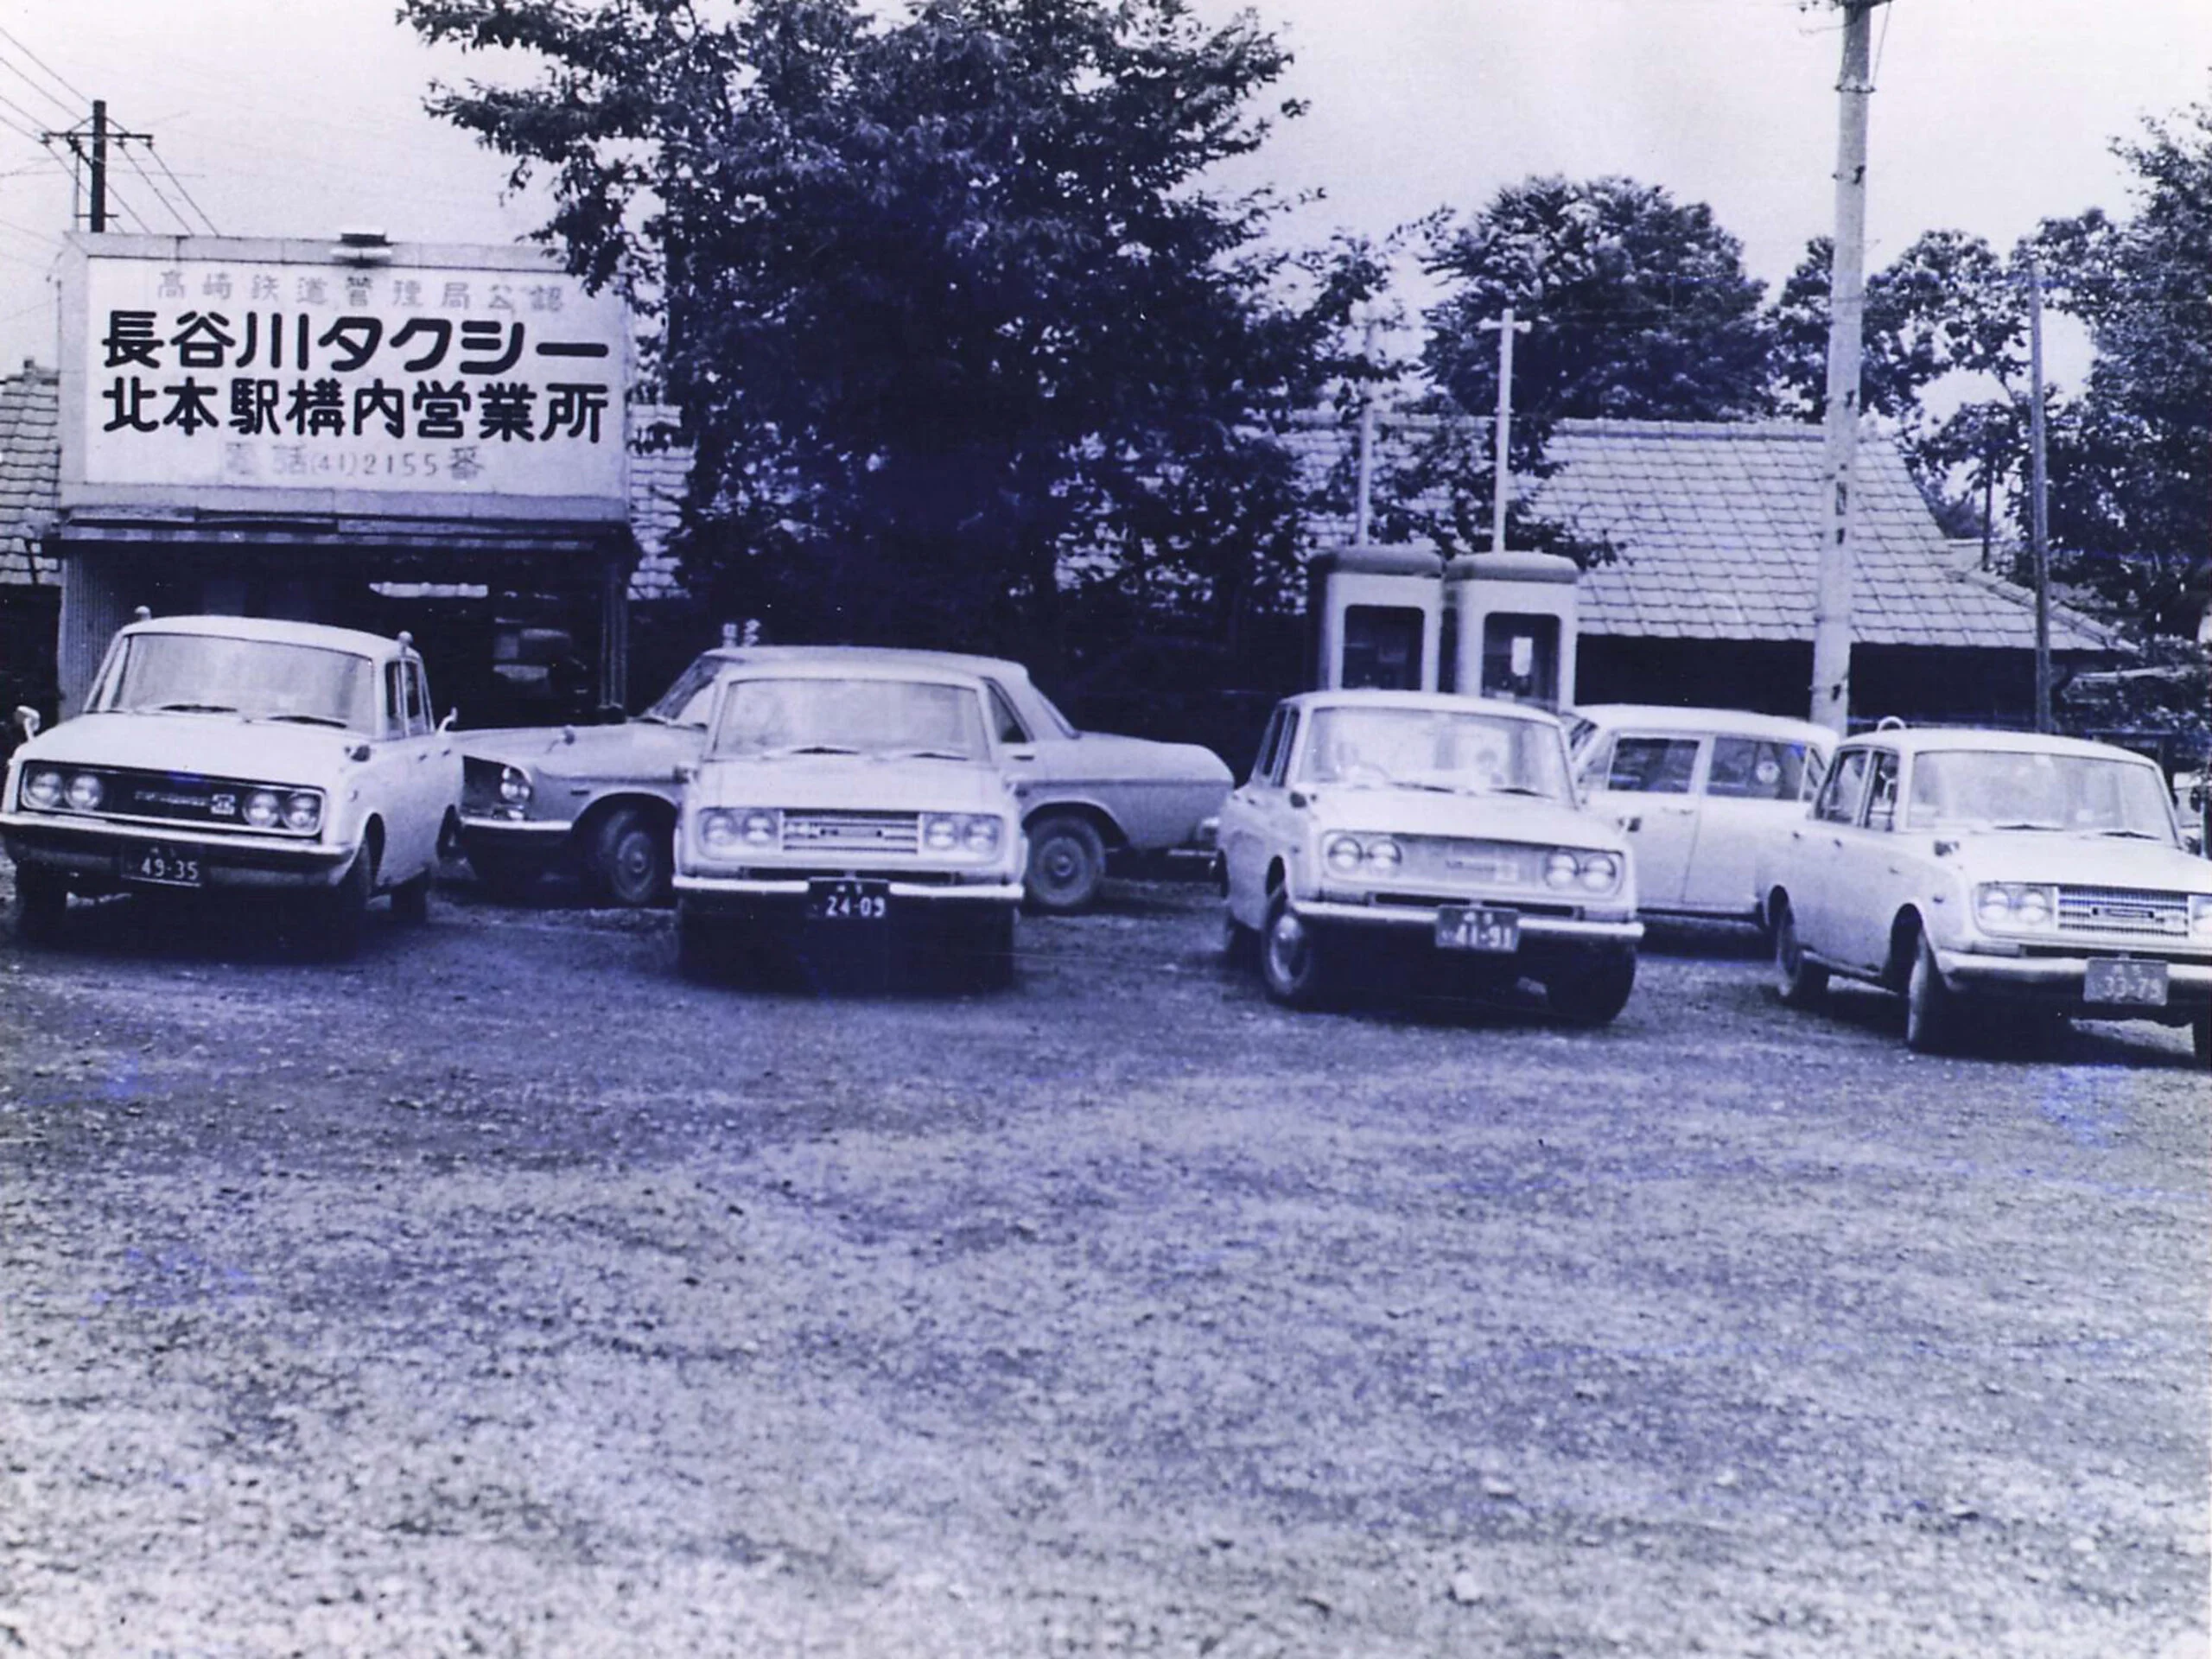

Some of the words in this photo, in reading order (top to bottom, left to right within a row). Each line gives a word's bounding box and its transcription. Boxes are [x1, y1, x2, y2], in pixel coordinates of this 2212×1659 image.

[102, 310, 608, 375] 長谷川タクシー
[102, 377, 608, 442] 北本駅構内営業所
[141, 857, 199, 880] 49-35
